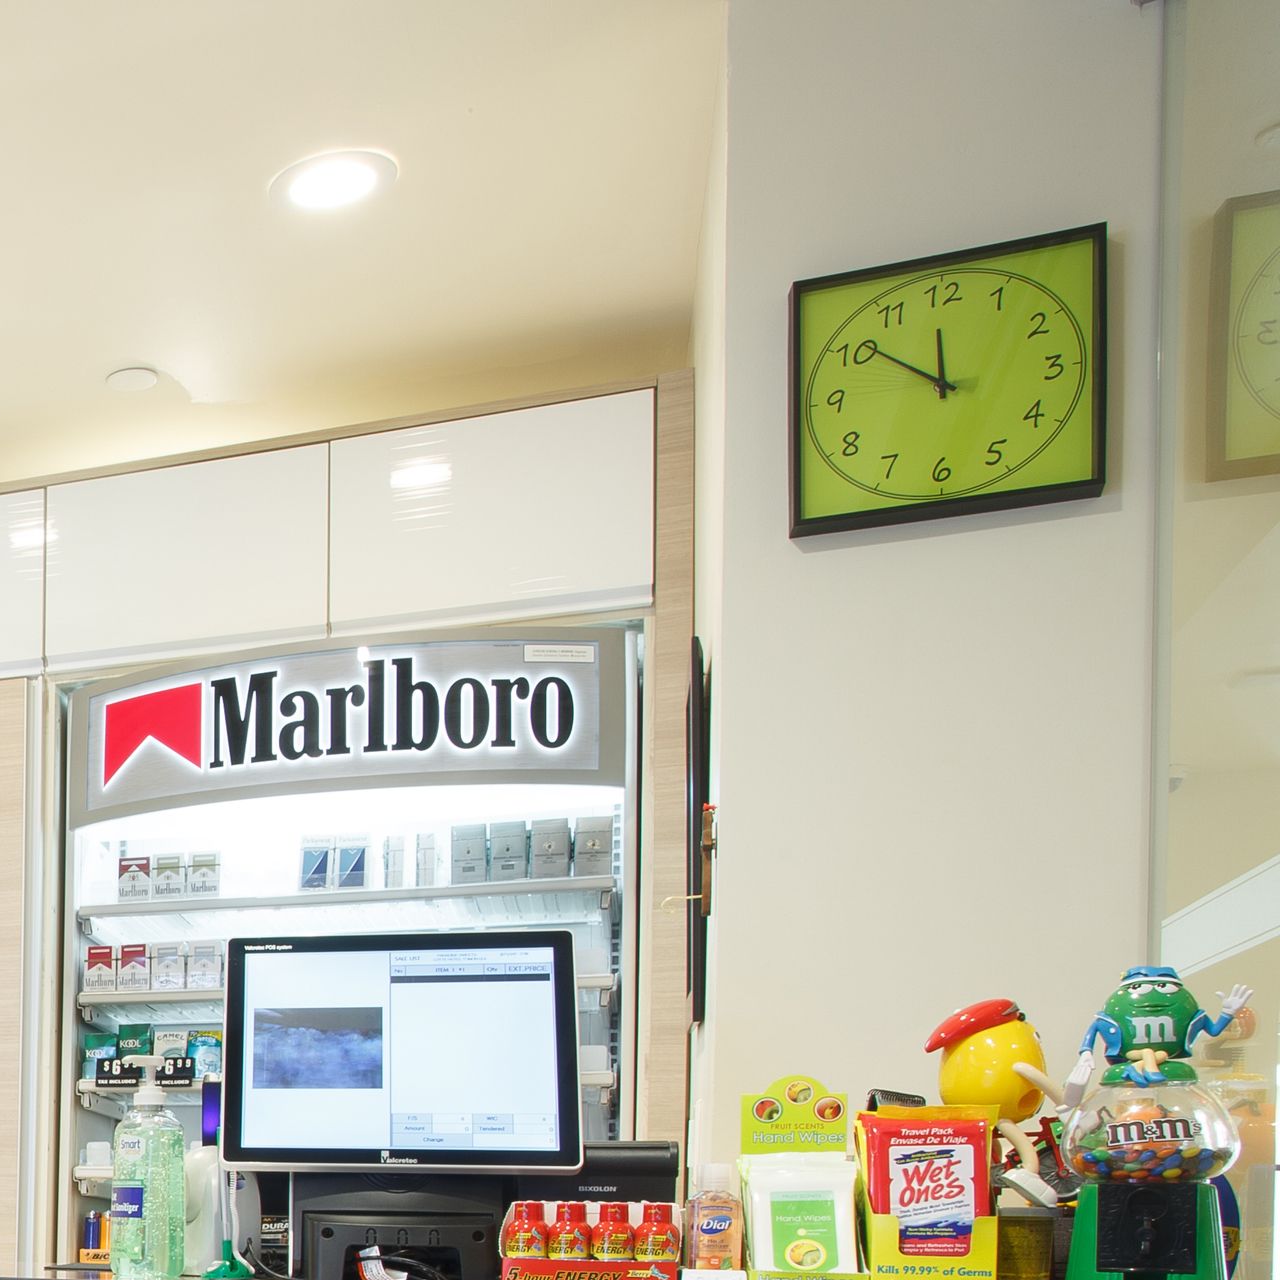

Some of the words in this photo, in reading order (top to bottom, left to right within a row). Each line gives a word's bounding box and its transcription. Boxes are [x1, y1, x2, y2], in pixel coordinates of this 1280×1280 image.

[924, 282, 962, 308] 12
[990, 286, 1004, 310] 1
[877, 303, 905, 328] 11
[1028, 313, 1050, 339] 2
[837, 339, 877, 367] 10
[1044, 354, 1064, 380] 3
[827, 389, 846, 414] 9
[1023, 399, 1044, 428] 4
[842, 431, 860, 456] 8
[985, 439, 1007, 466] 5
[881, 454, 899, 479] 7
[932, 457, 950, 482] 6
[209, 658, 575, 769] Marlboro
[120, 1039, 141, 1048] KOOL
[157, 1032, 185, 1041] CAMEL
[86, 1049, 108, 1058] KOOL
[753, 1132, 794, 1143] Hand
[799, 1132, 845, 1145] Wipes
[901, 1128, 930, 1136] Travel
[942, 1136, 968, 1144] Viaje
[121, 1140, 141, 1150] Smart
[902, 1159, 961, 1187] Wet
[899, 1177, 965, 1207] Ones
[702, 1217, 731, 1230] Dial
[877, 1265, 899, 1274] Kills
[903, 1266, 939, 1275] 99.99%
[943, 1267, 954, 1276] of
[957, 1267, 992, 1277] Germs
